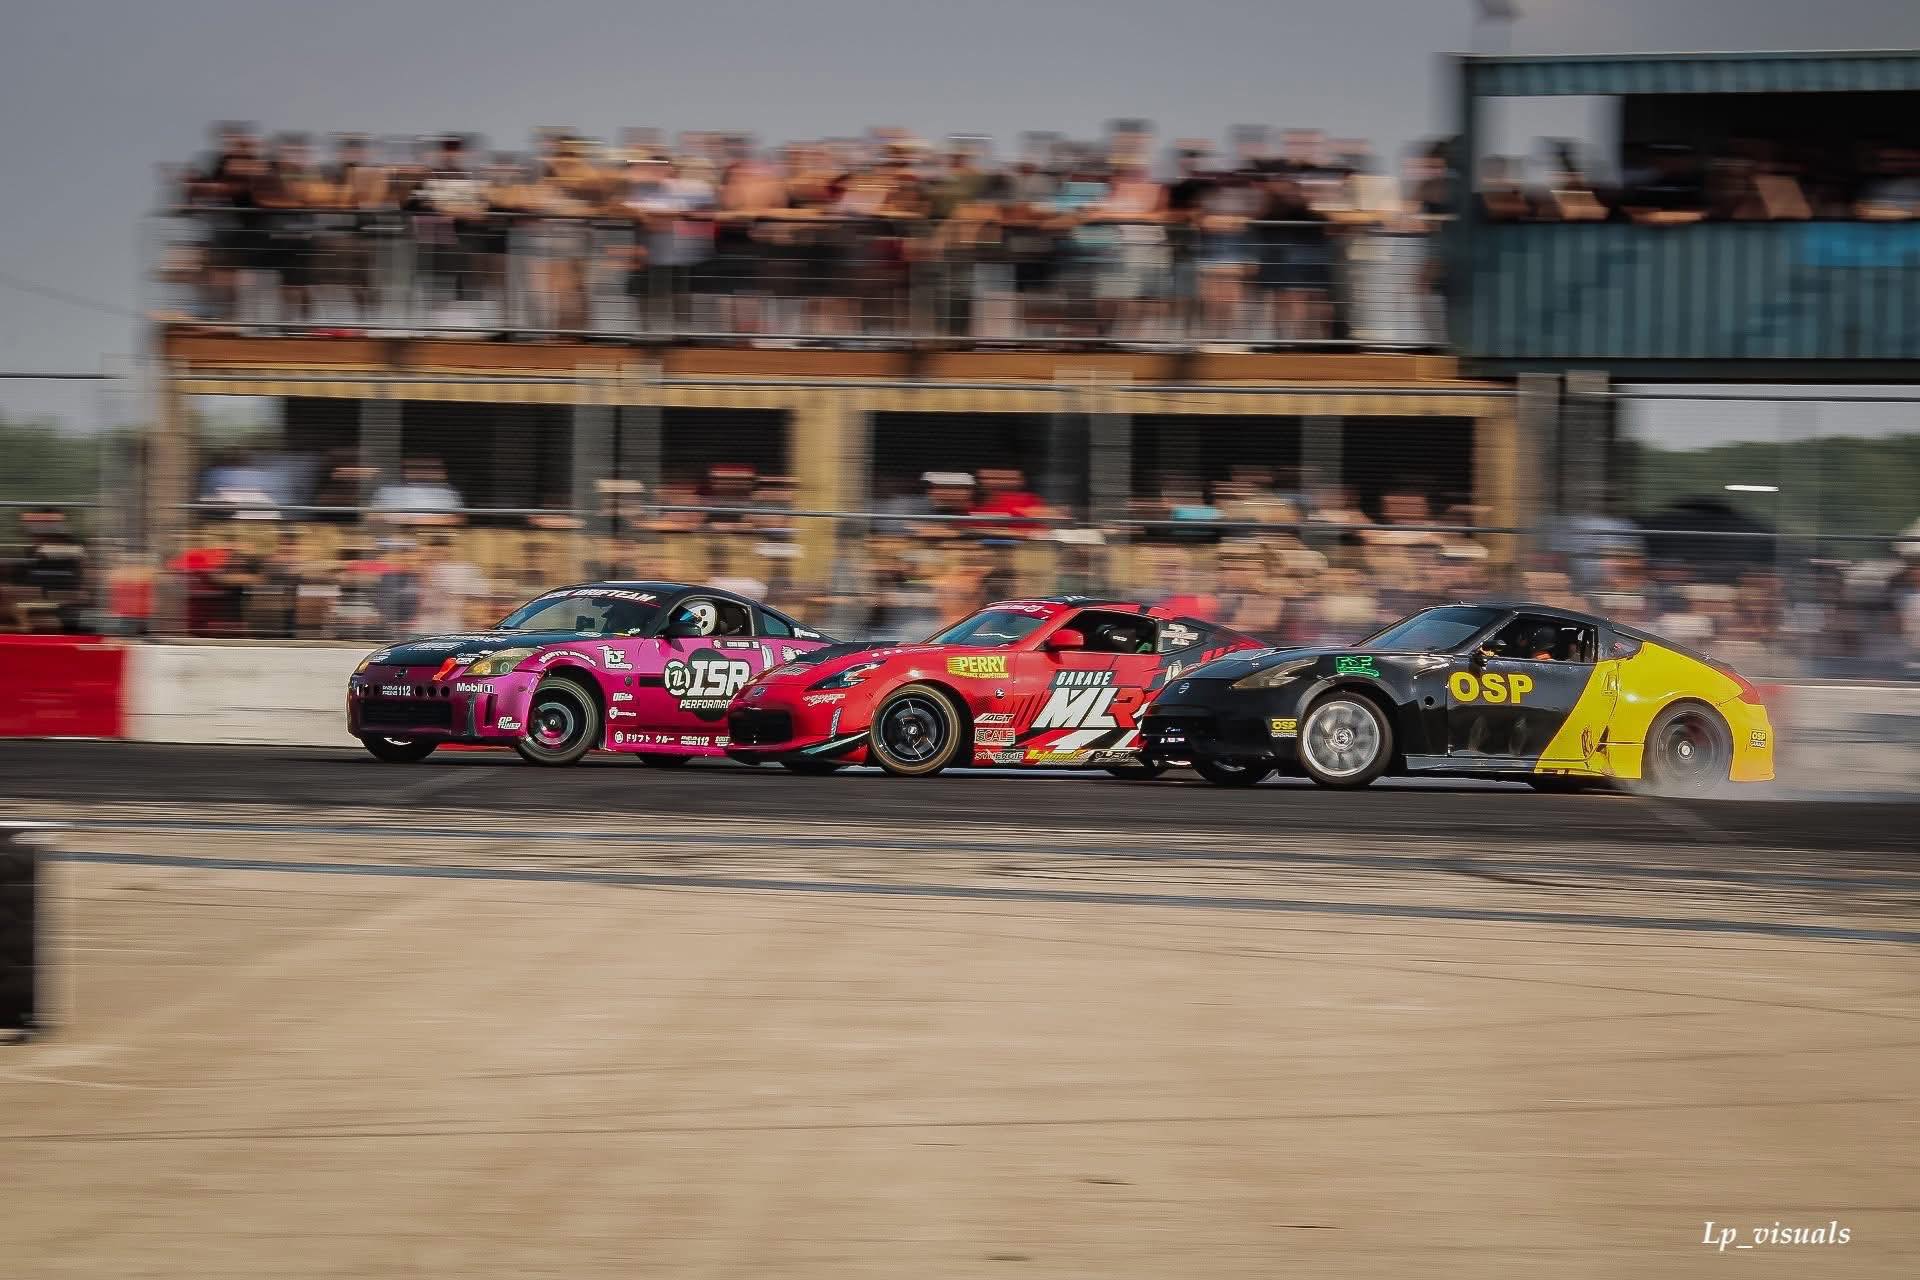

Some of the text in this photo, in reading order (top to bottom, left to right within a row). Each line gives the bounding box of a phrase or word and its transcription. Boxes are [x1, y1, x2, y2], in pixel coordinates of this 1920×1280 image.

[959, 656, 1006, 673] PERRY
[687, 660, 750, 696] ISR
[1056, 671, 1113, 685] GARAGE
[398, 686, 411, 697] 112
[456, 682, 483, 693] Mobil
[1449, 672, 1533, 703] OSP
[1031, 688, 1145, 728] MLR
[1271, 721, 1296, 730] OSP
